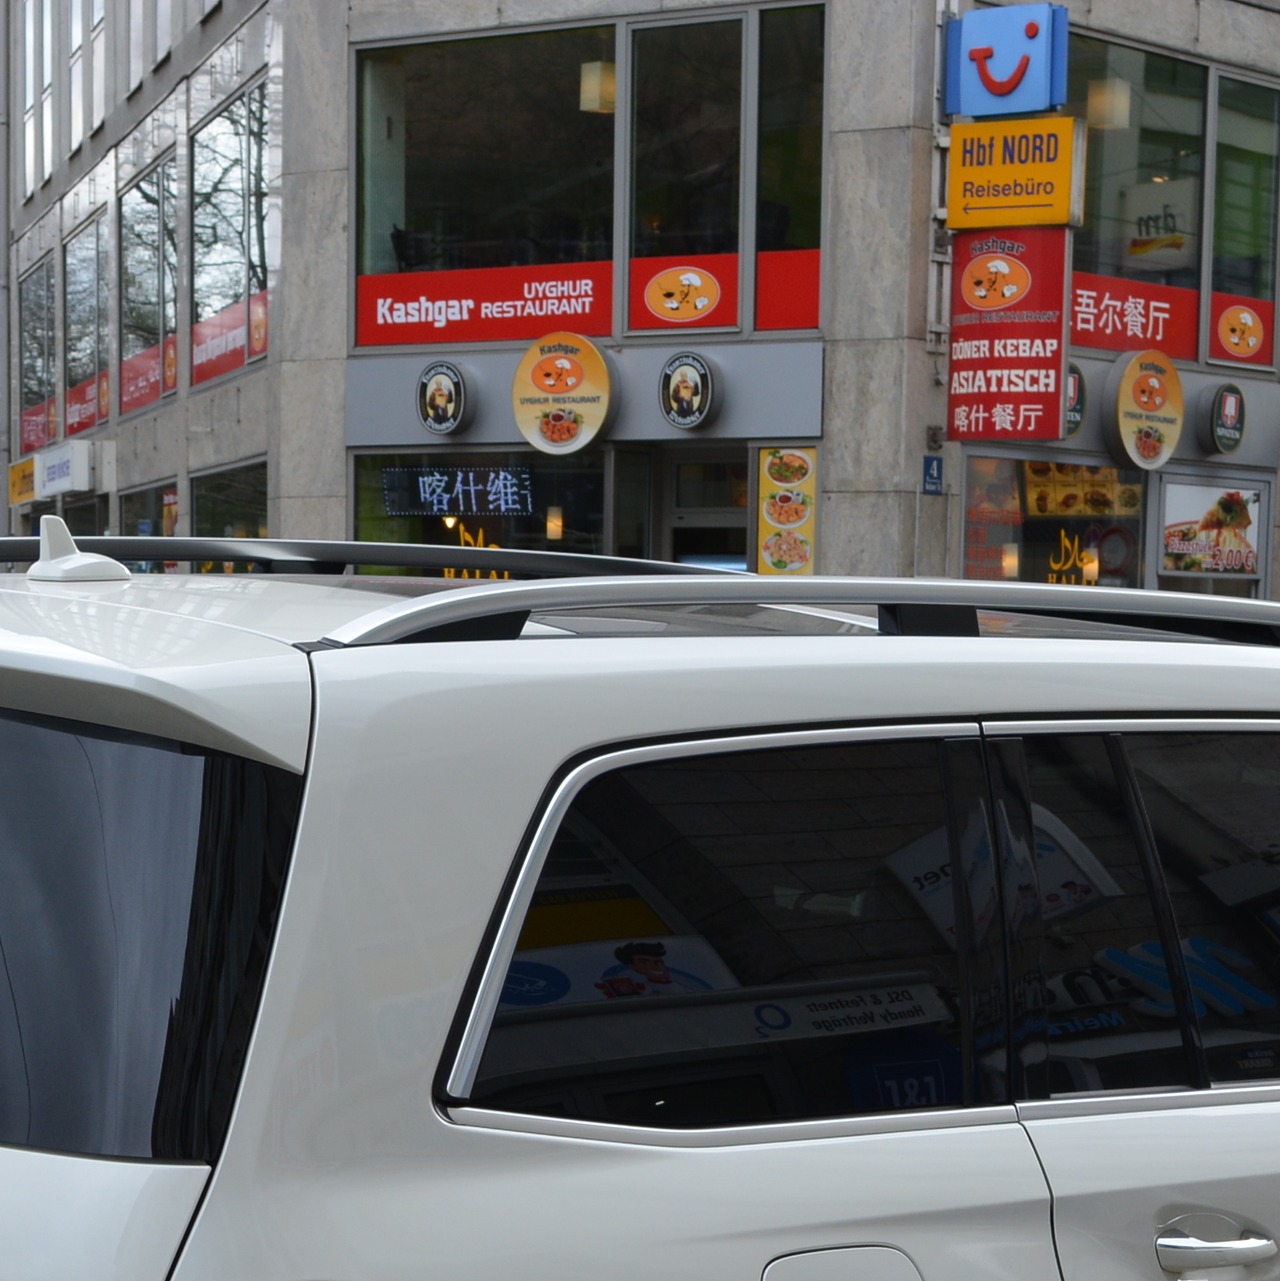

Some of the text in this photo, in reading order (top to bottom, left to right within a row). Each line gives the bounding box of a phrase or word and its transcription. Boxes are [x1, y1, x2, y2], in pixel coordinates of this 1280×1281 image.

[962, 133, 1059, 167] Hbf NORD
[962, 178, 1054, 198] Reisebüro
[523, 279, 593, 299] UYGHUR
[377, 296, 474, 328] Kashgar
[481, 297, 593, 319] RESTAURANT
[982, 310, 1059, 323] RESTAURANT
[1070, 289, 1170, 341] 吾尔餐厅
[538, 342, 581, 356] Kashgar
[952, 338, 1058, 360] DÖNER KEBAP
[951, 369, 1056, 394] ASIATISCH
[551, 395, 601, 405] RESTAURANT
[954, 403, 1043, 432] 喀什餐厅
[1216, 427, 1240, 440] SPATEN
[929, 460, 938, 478] 4
[1214, 548, 1255, 571] 2,00 €
